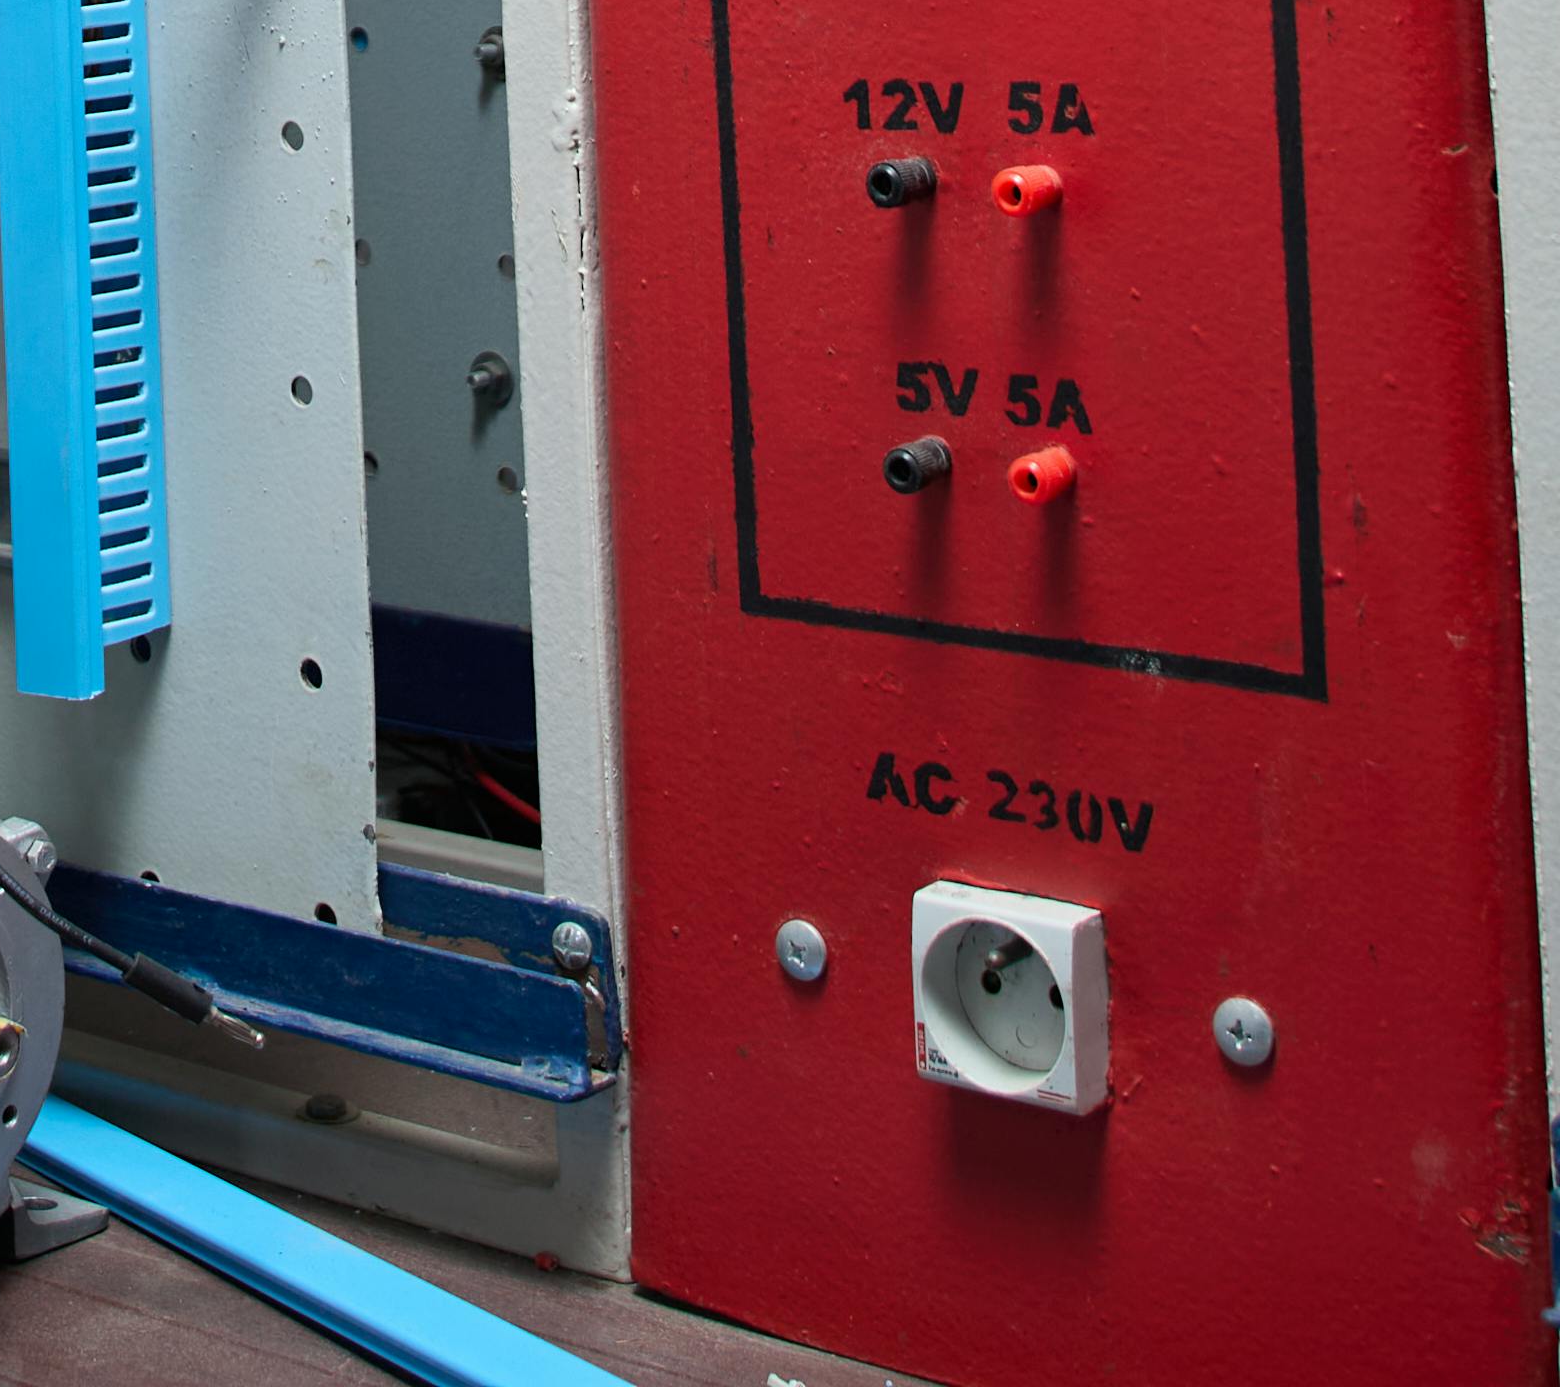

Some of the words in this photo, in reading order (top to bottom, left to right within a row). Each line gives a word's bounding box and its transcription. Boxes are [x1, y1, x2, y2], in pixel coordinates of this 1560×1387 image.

[843, 78, 965, 135] 12V
[1007, 81, 1096, 136] 5A
[896, 361, 979, 417] 5V
[1004, 373, 1093, 436] 5A
[865, 752, 959, 817] AC
[986, 769, 1156, 854] 230V
